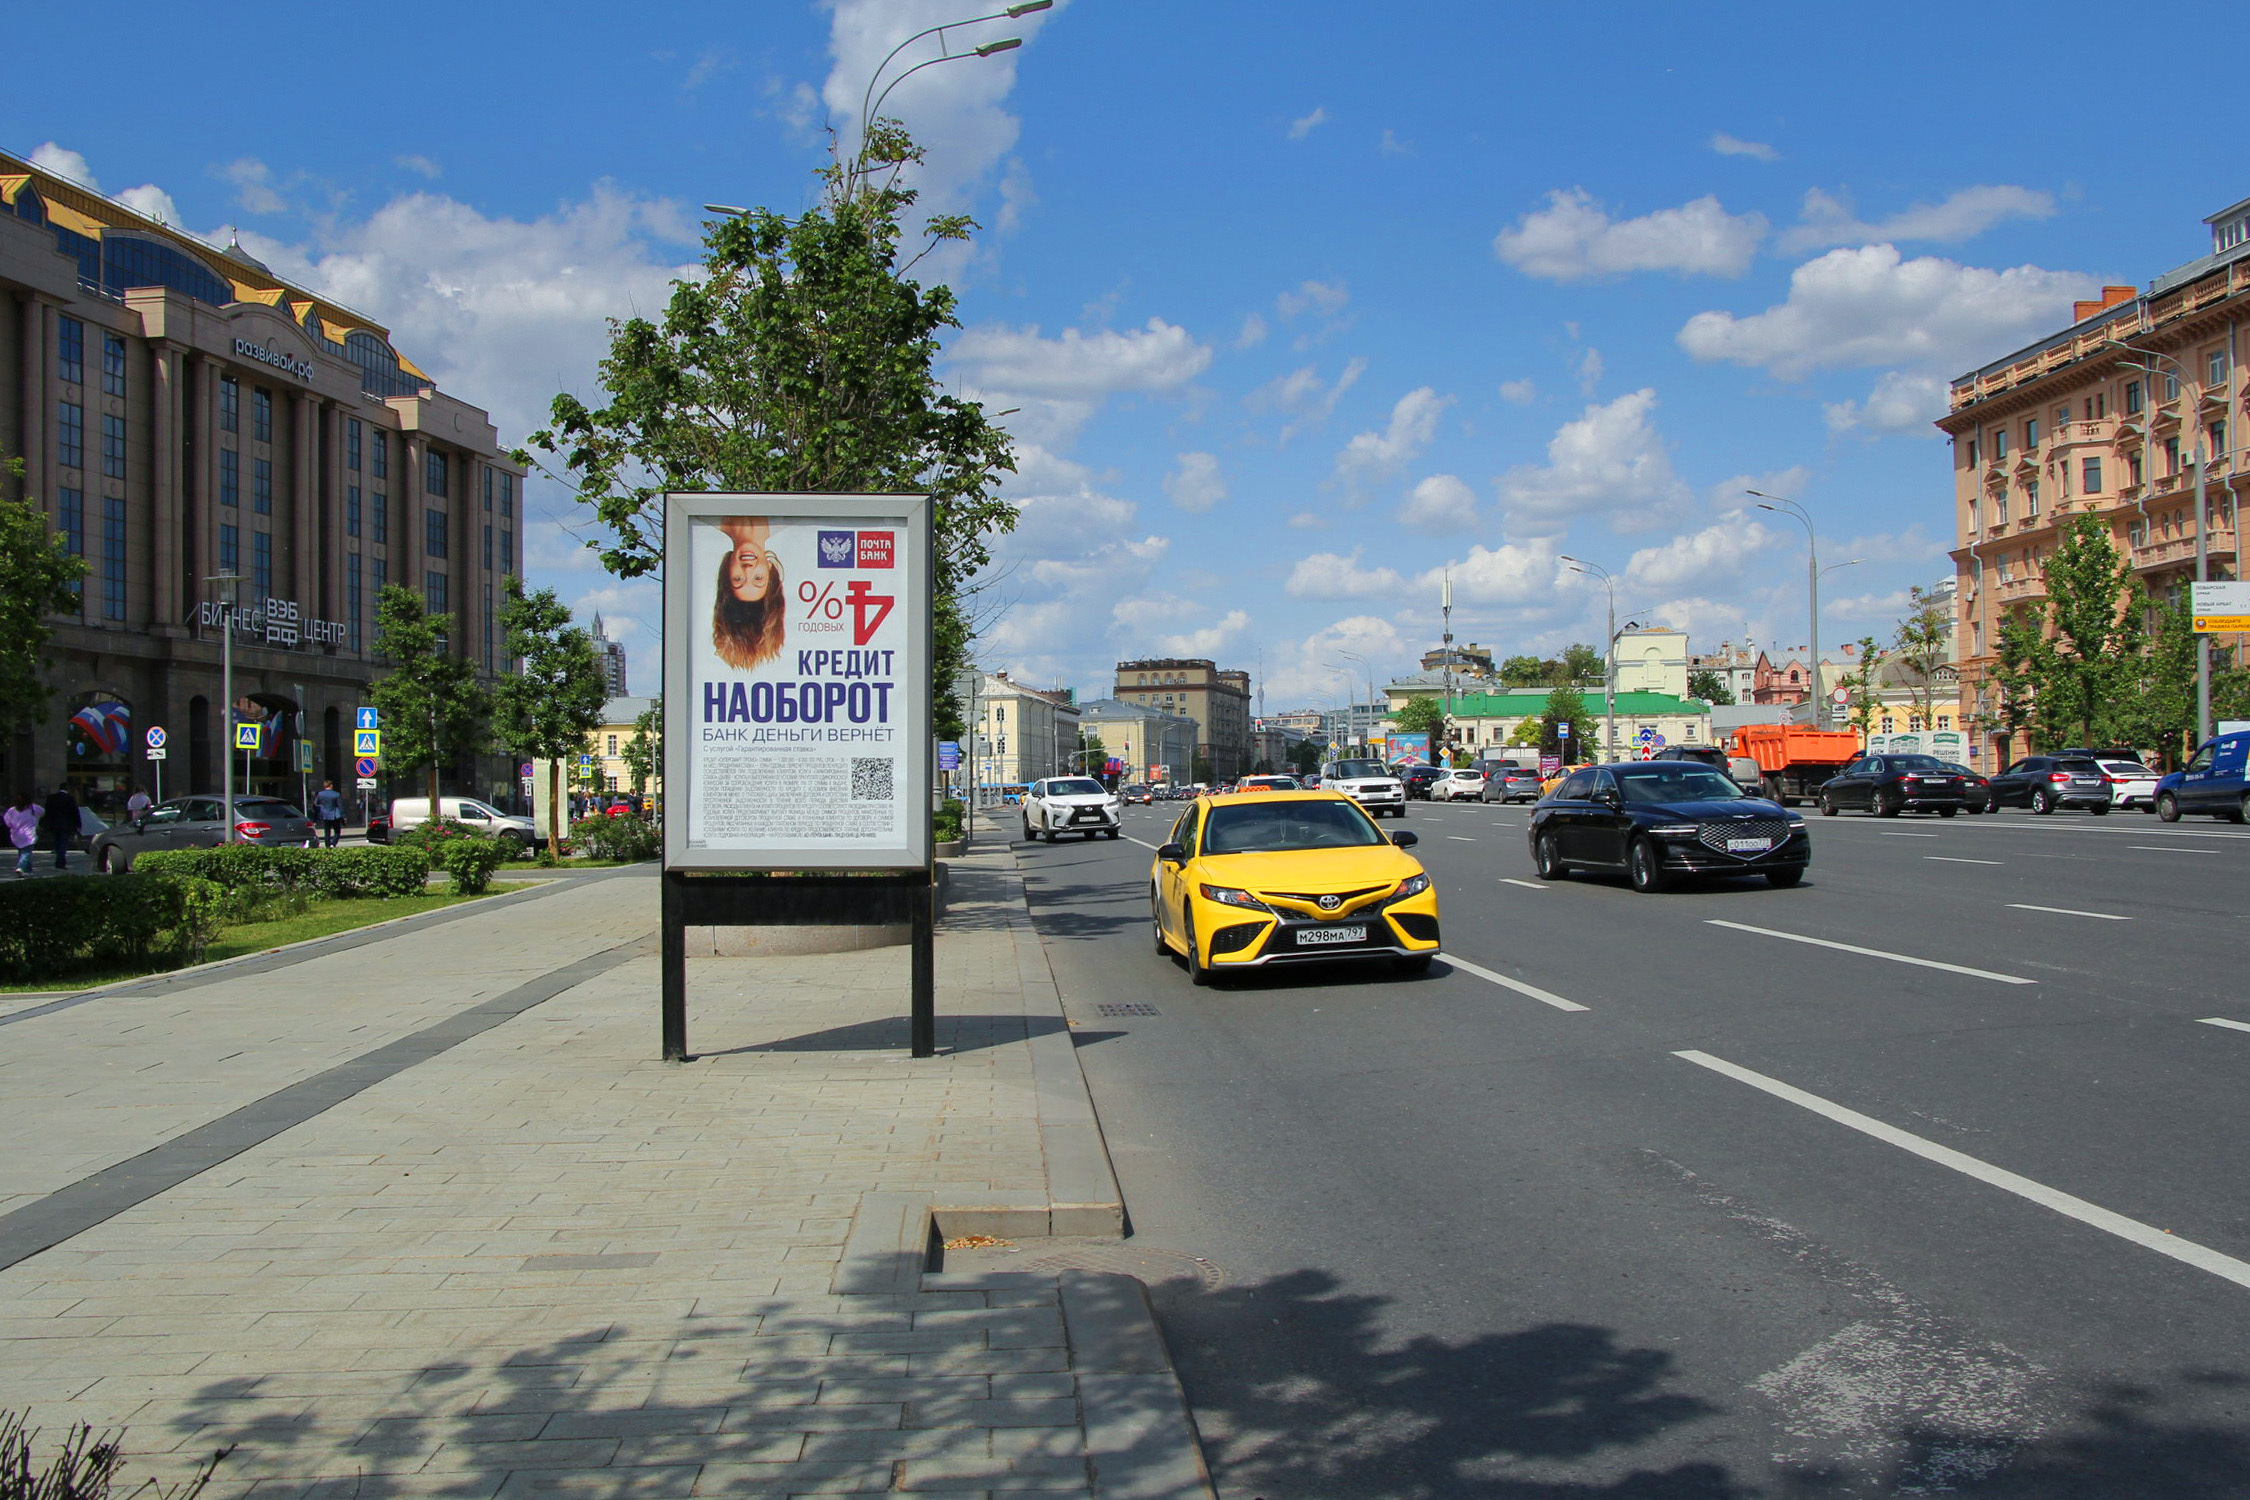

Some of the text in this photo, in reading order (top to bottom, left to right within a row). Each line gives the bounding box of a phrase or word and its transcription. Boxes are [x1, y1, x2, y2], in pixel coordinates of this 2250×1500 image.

[235, 338, 314, 382] развивай.рф
[860, 539, 891, 549] ПОЧТА
[860, 550, 887, 561] БАНК
[266, 597, 298, 620] ВЭБ
[201, 601, 346, 644] БИНЕС ЦЕНТР
[798, 622, 844, 633] ГОДОВЫХ
[266, 626, 298, 647] РФ
[798, 650, 895, 679] КРЕДИТ
[704, 682, 895, 724] НАОБОРОТ
[703, 726, 895, 743] БАНК ДЕНЬГИ ВЕРНЁТ
